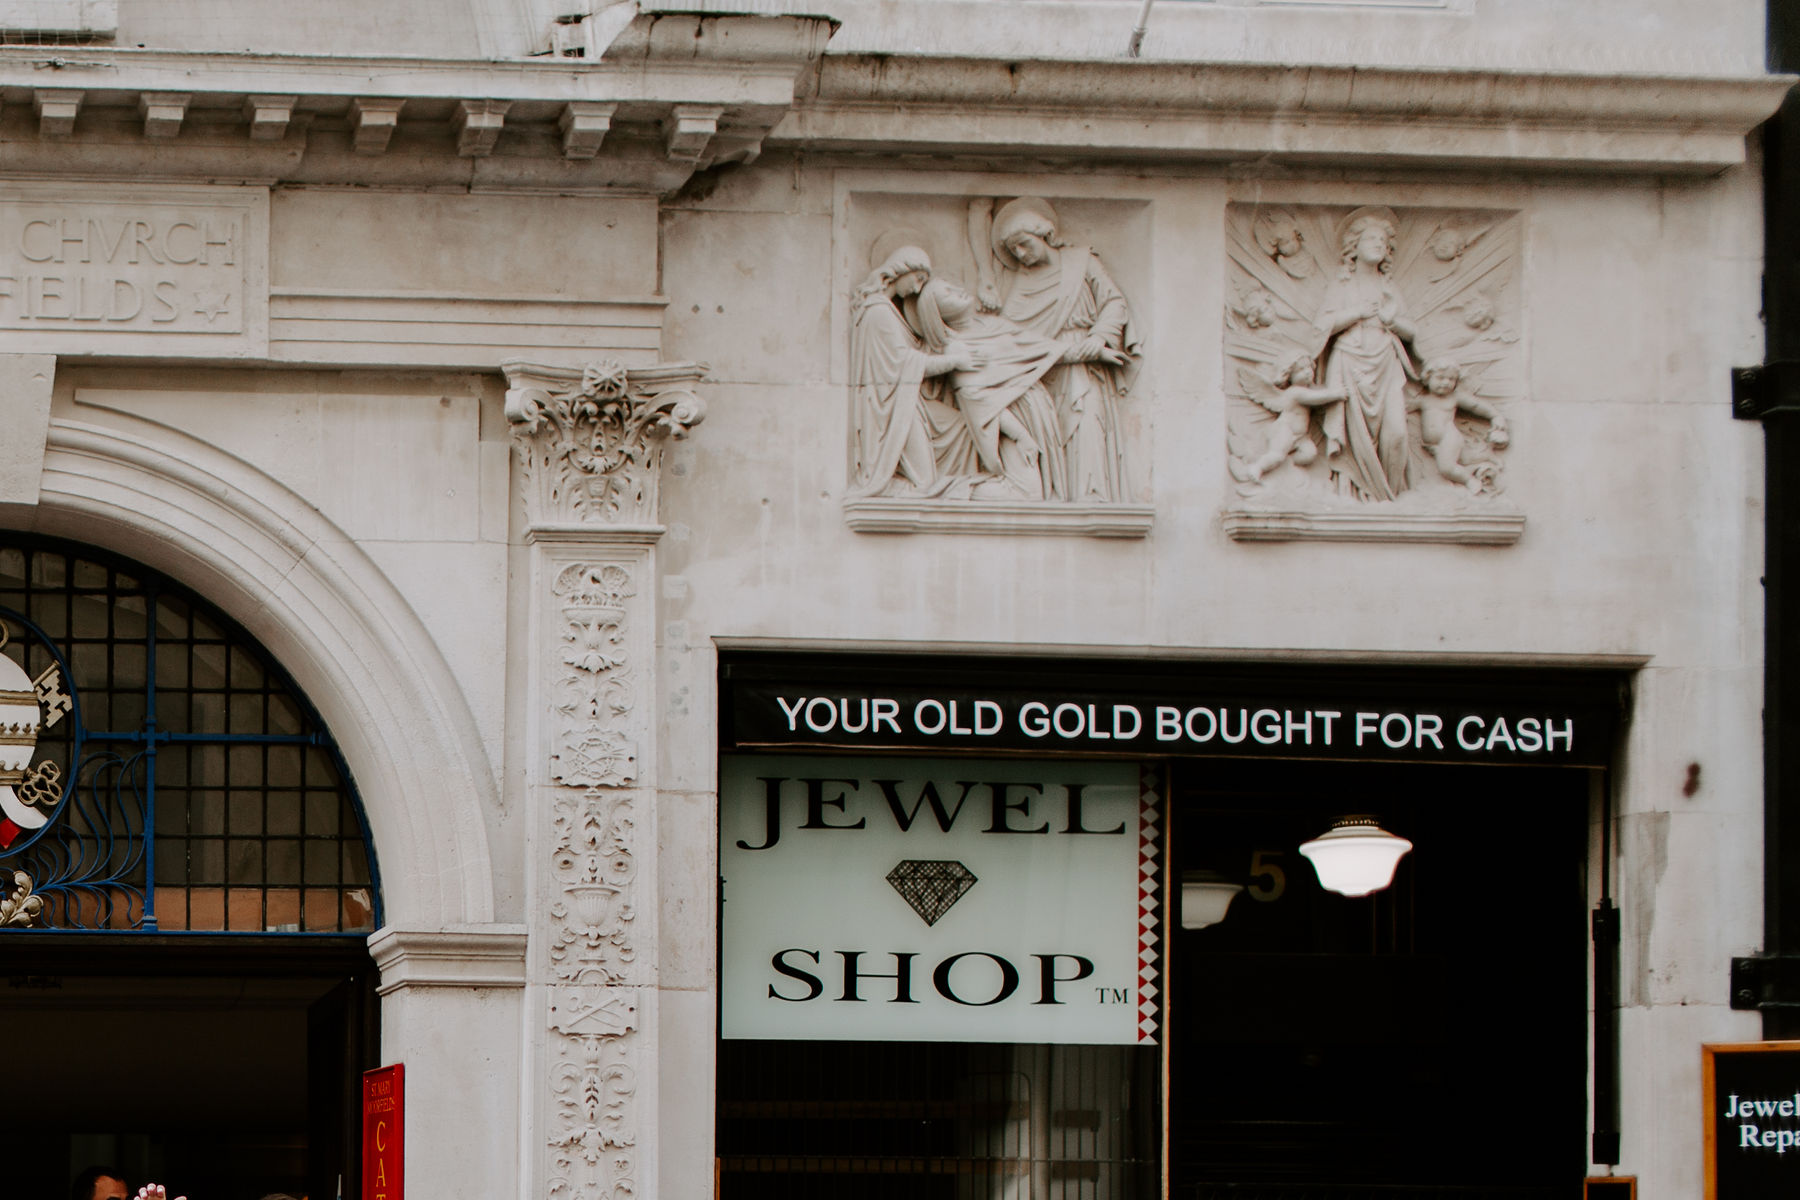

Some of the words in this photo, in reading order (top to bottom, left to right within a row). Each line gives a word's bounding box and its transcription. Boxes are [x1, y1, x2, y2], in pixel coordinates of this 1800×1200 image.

[776, 696, 903, 735] YOUR
[914, 699, 1003, 737] OLD
[1018, 701, 1142, 741] GOLD
[1156, 706, 1342, 746] BOUGHT
[1355, 712, 1445, 751] FOR
[1456, 715, 1575, 753] CASH
[736, 776, 1127, 851] JEWEL
[1248, 848, 1287, 902] 5
[768, 948, 1095, 1007] SHOP
